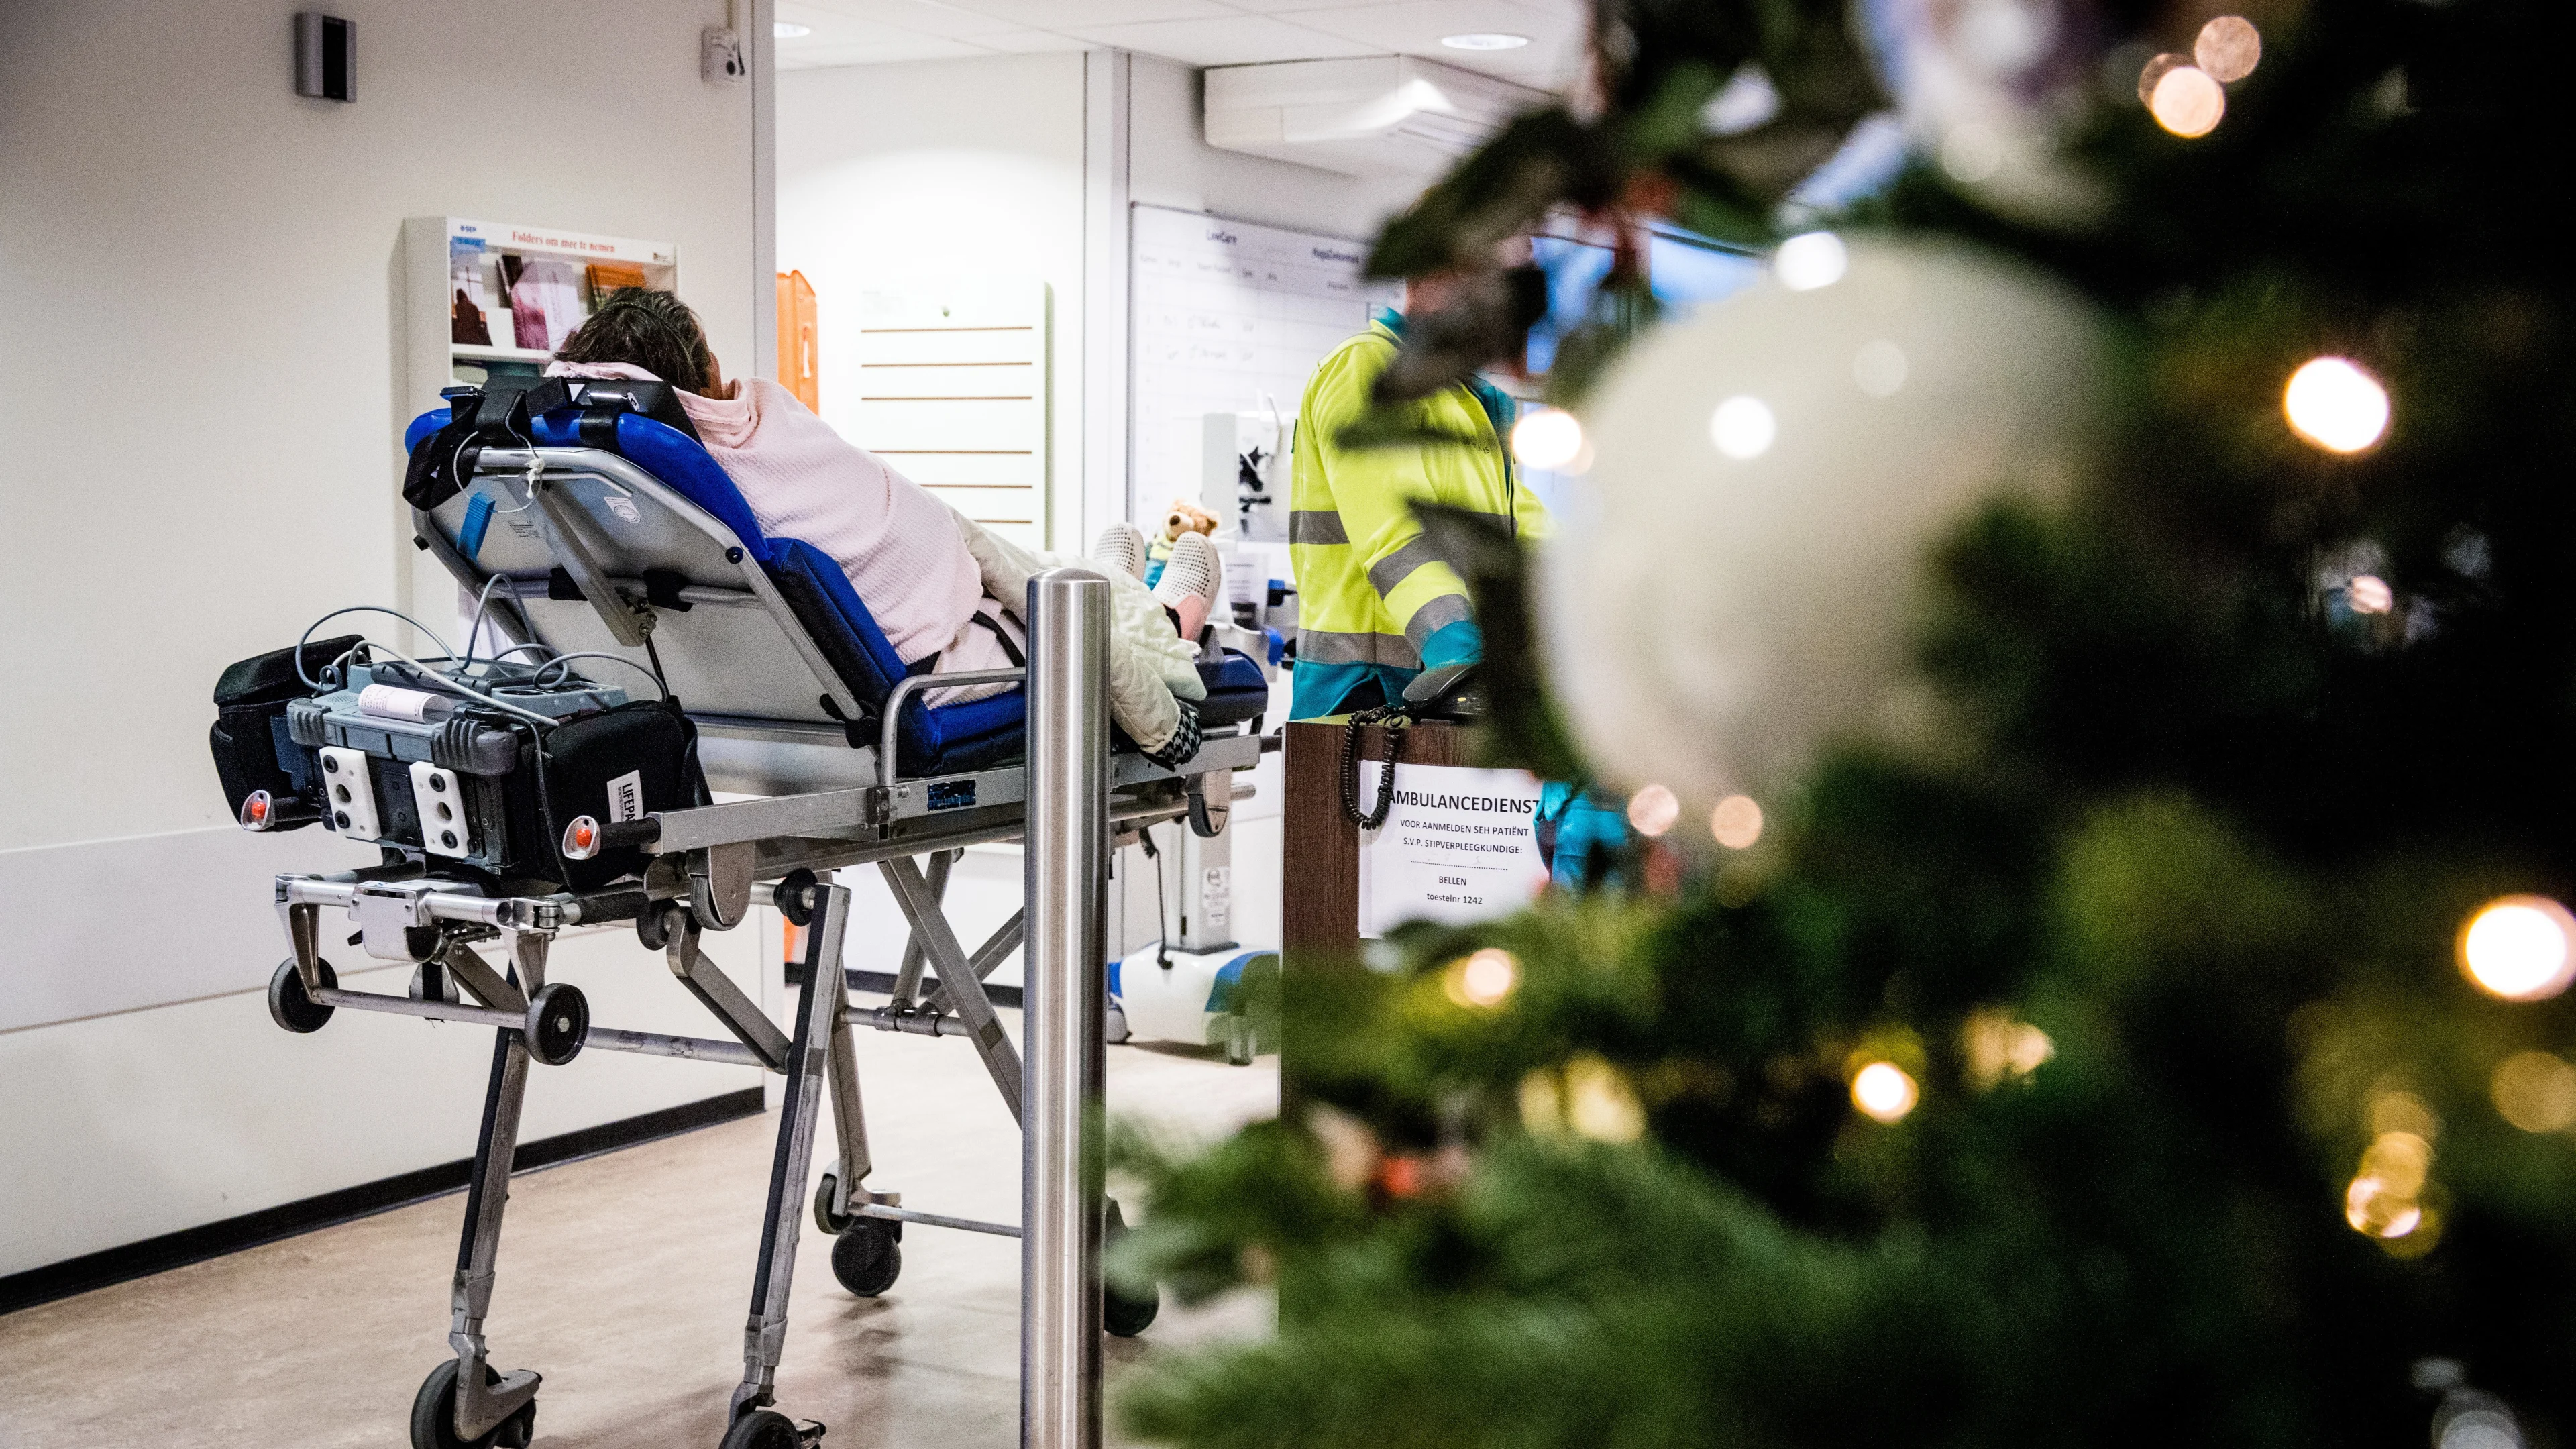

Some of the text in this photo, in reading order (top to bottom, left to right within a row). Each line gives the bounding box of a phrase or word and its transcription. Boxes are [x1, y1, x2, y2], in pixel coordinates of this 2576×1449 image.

[512, 230, 615, 253] Folders om mee te nemen
[622, 782, 635, 821] LIFEPA
[1400, 819, 1529, 836] VOOR AANMELDEN SEH PATIËNT
[1403, 837, 1522, 853] S.V.P. STIPVERPLEEGKUNDIGE:
[1439, 876, 1466, 885] BELLEN
[1427, 893, 1483, 904] toestelnr 1242
